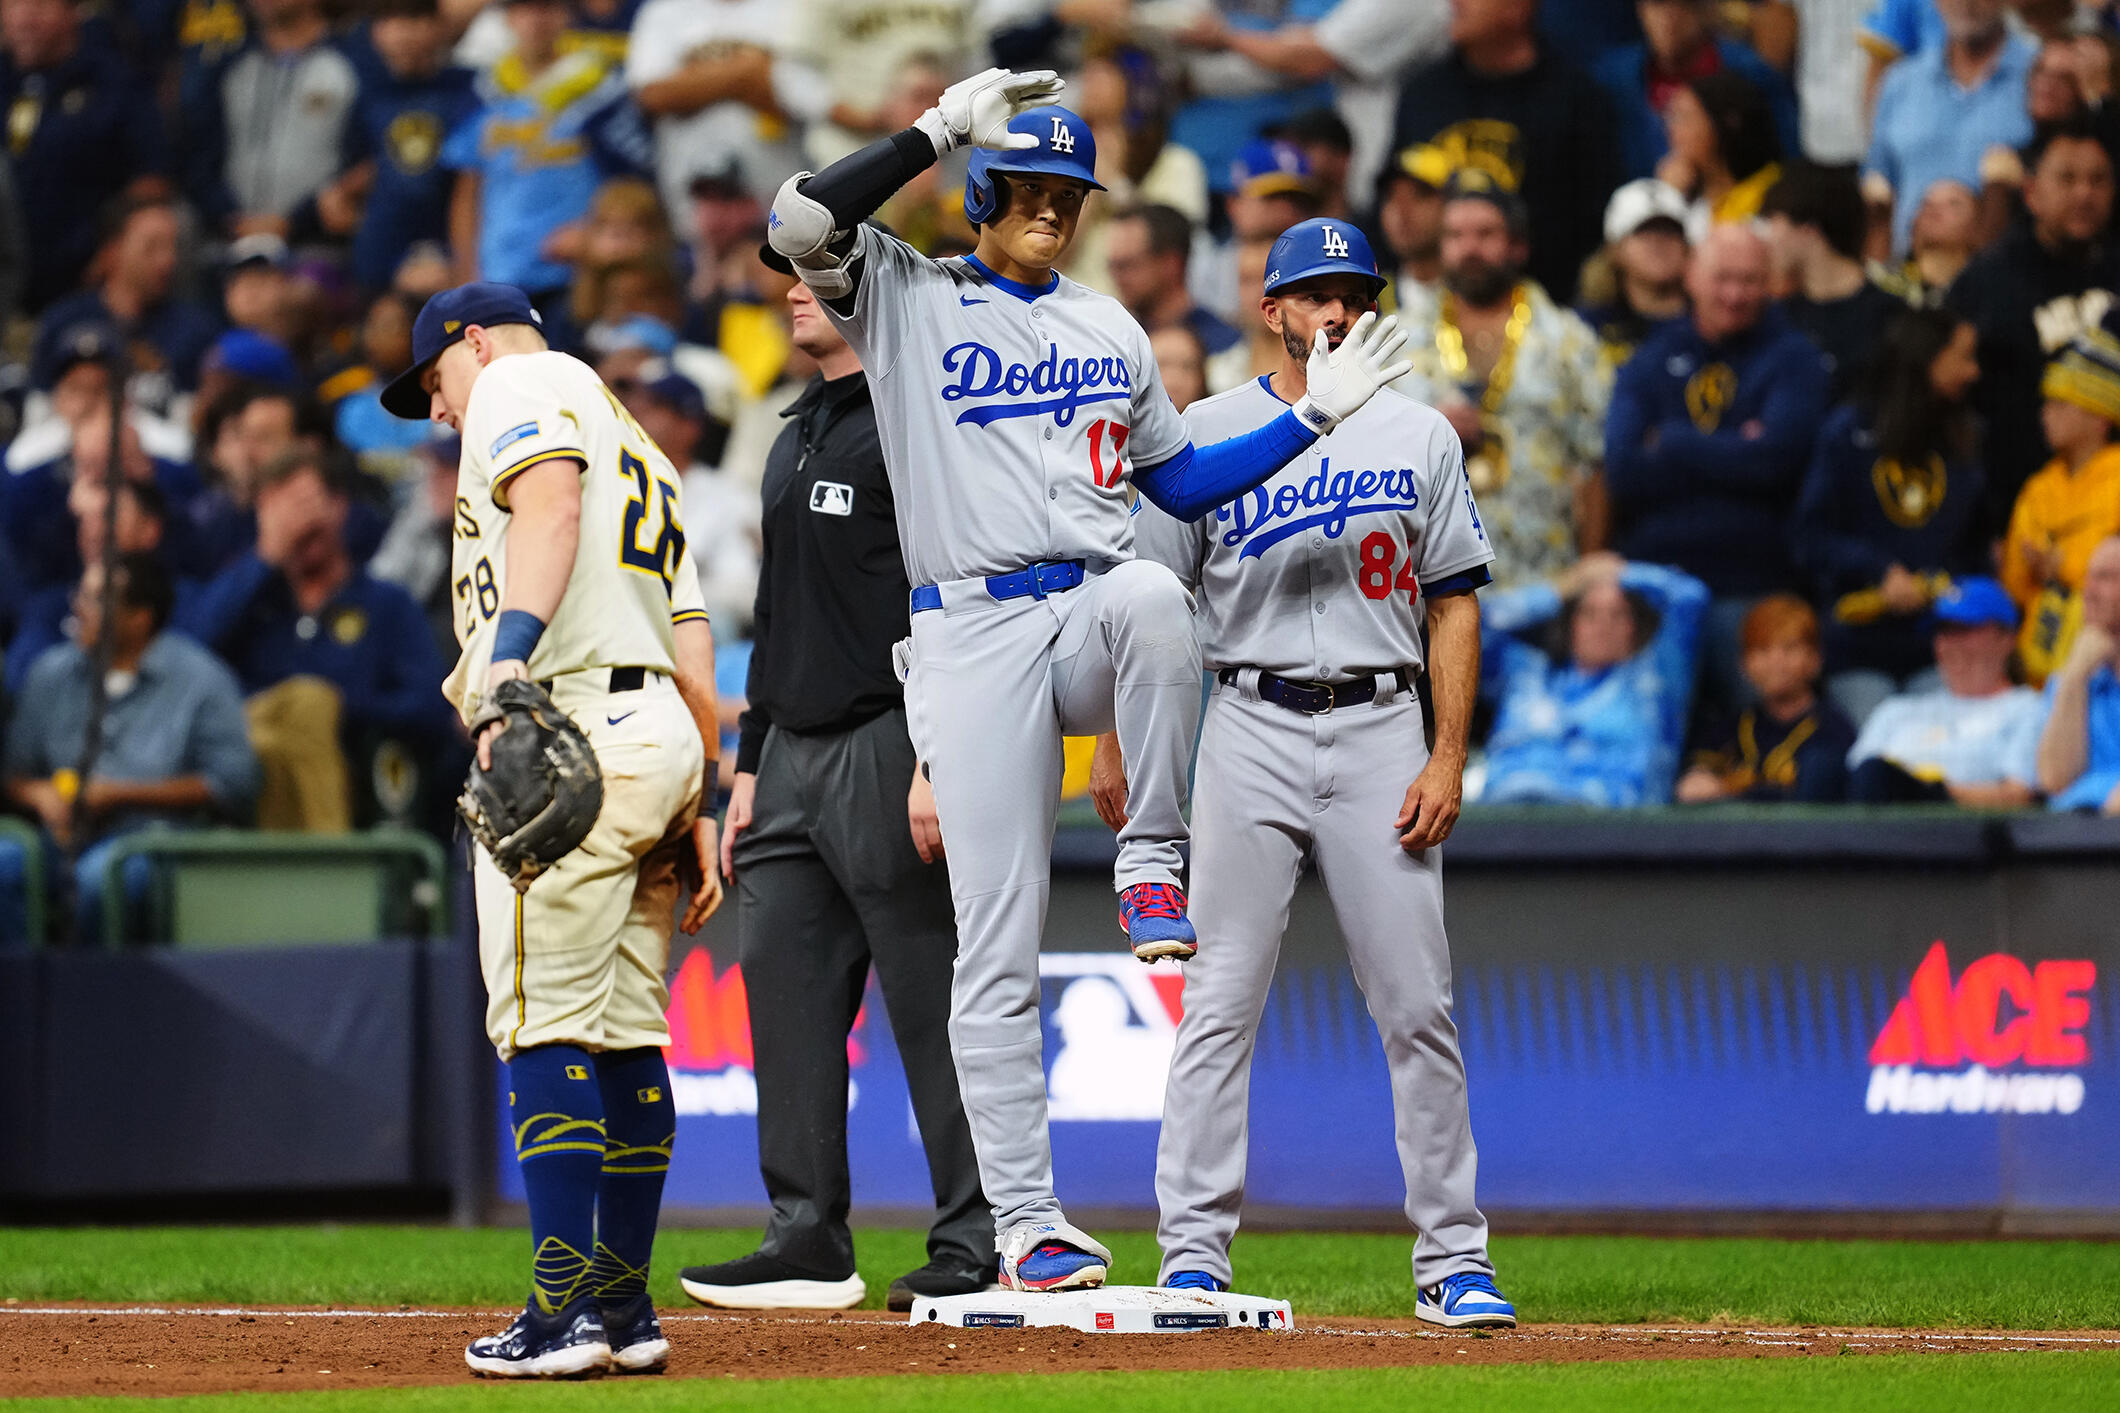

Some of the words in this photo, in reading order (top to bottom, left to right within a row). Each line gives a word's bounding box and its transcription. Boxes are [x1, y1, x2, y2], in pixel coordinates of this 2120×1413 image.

[1050, 117, 1075, 153] LA
[1322, 226, 1349, 258] LA
[941, 341, 1131, 428] Dodgers
[1087, 418, 1130, 490] 17
[453, 496, 480, 541] S
[618, 443, 687, 608] 26
[1216, 457, 1418, 547] Dodgers
[455, 556, 499, 638] 28
[1359, 531, 1418, 606] 84
[1868, 940, 2096, 1067] ACE
